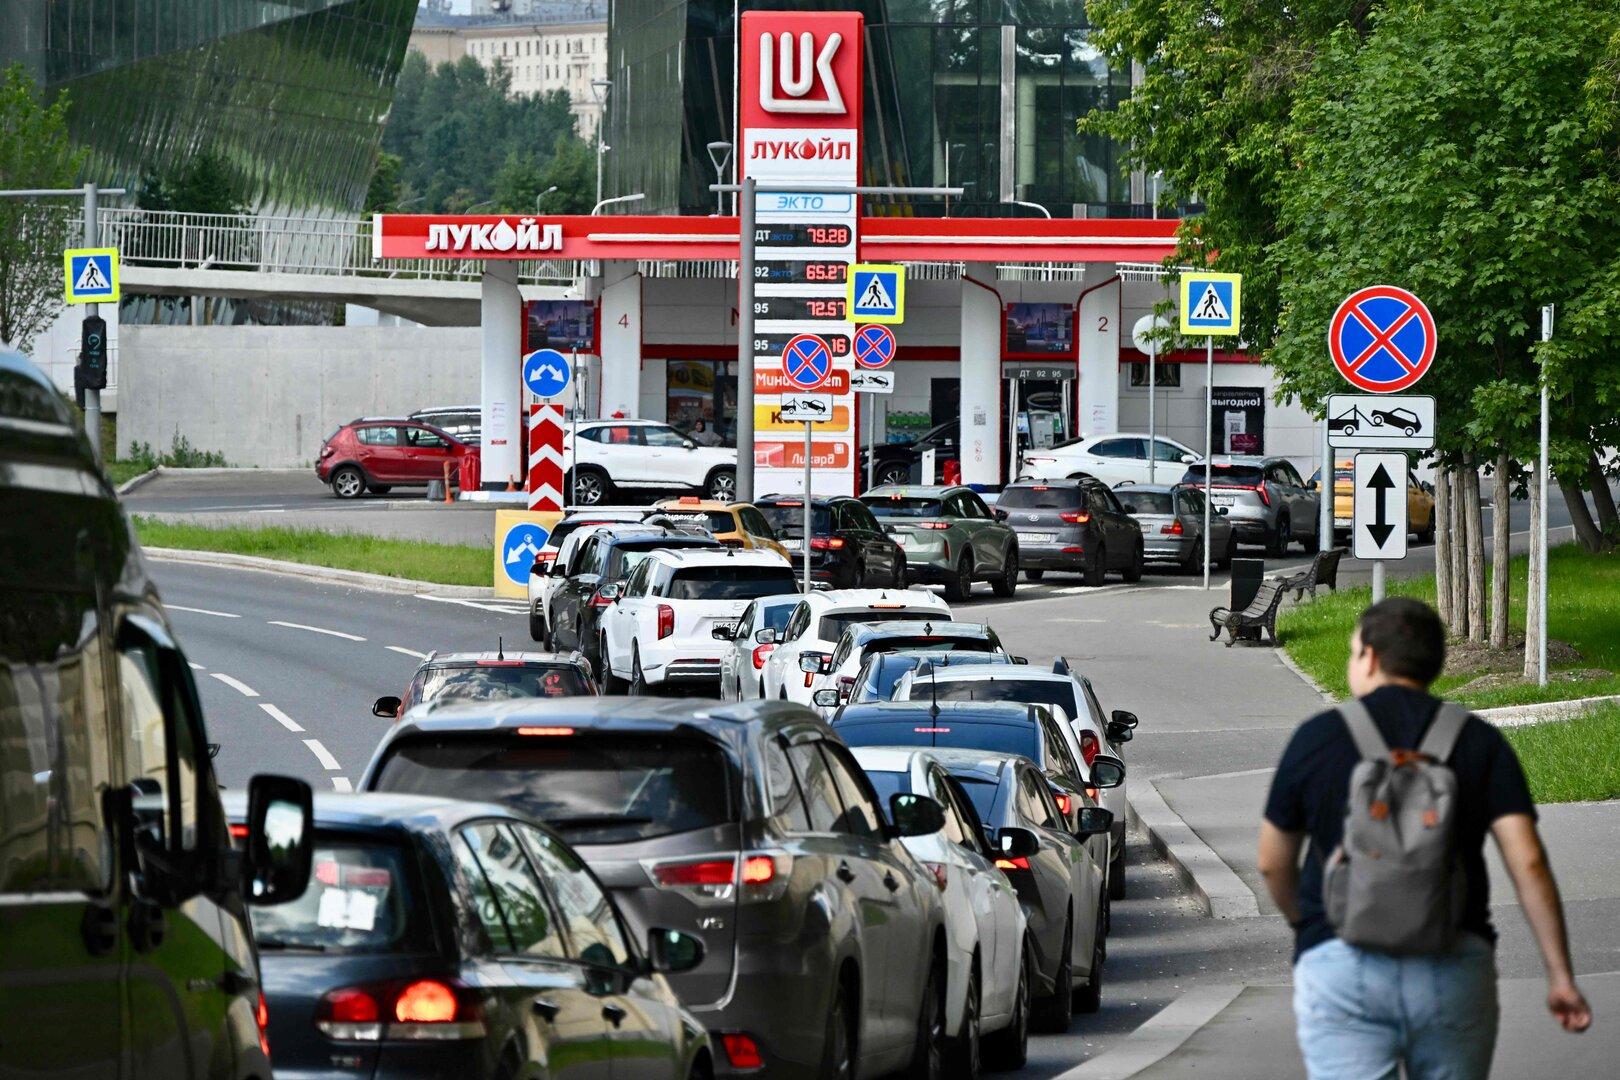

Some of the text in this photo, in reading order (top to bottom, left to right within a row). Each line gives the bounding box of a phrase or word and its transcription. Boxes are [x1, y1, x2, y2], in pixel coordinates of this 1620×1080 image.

[777, 195, 824, 210] ЭКТО
[755, 230, 771, 242] ДТ
[807, 228, 848, 243] 79.28
[754, 266, 769, 278] 92
[806, 265, 847, 280] 65.27
[754, 301, 846, 316] 95 72.57
[618, 313, 629, 329] 4
[1097, 316, 1109, 332] 2
[754, 339, 769, 351] 95
[770, 343, 785, 351] ЭКТ
[1019, 370, 1062, 379] ДТ 92 95
[1211, 397, 1261, 408] выгодно!
